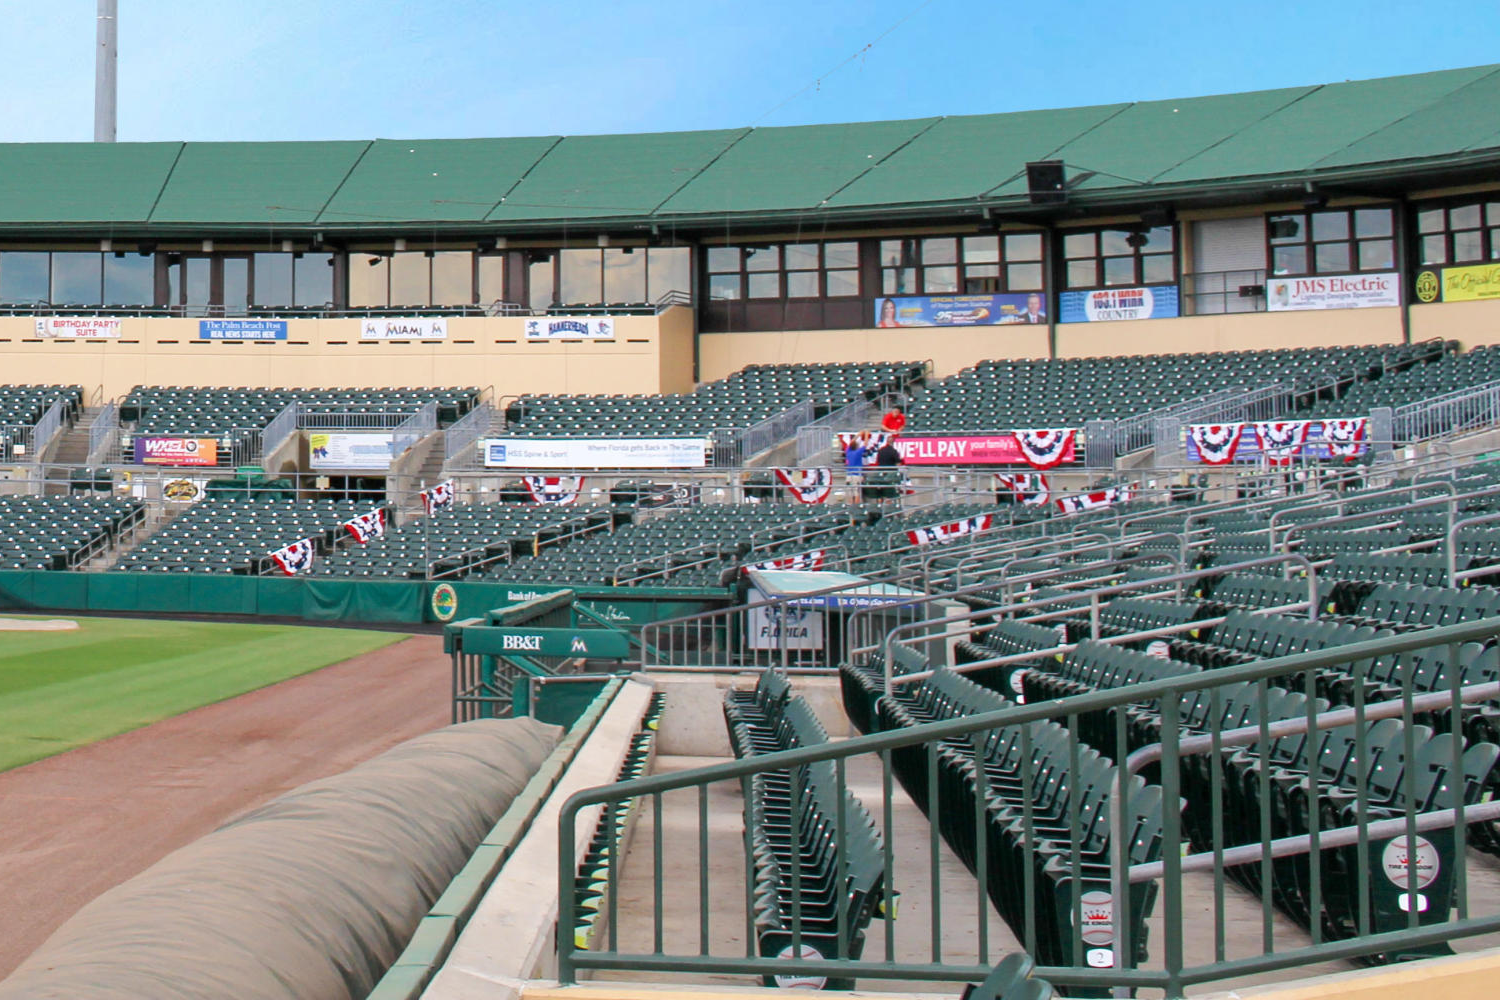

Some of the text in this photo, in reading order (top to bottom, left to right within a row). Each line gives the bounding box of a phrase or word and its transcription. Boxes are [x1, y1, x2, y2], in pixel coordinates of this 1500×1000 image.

[1292, 277, 1389, 298] JMS Electric
[53, 320, 119, 328] BIRTHDAY PARTY
[206, 321, 220, 329] The
[221, 321, 240, 329] Palm
[242, 321, 264, 329] Beach
[385, 322, 422, 336] MIAMI
[76, 329, 97, 337] SUITE
[145, 440, 185, 452] WXEL
[893, 440, 967, 458] WE'LL PAY
[508, 591, 524, 600] Bank
[503, 635, 543, 650] BB&T
[1097, 952, 1105, 964] 2
